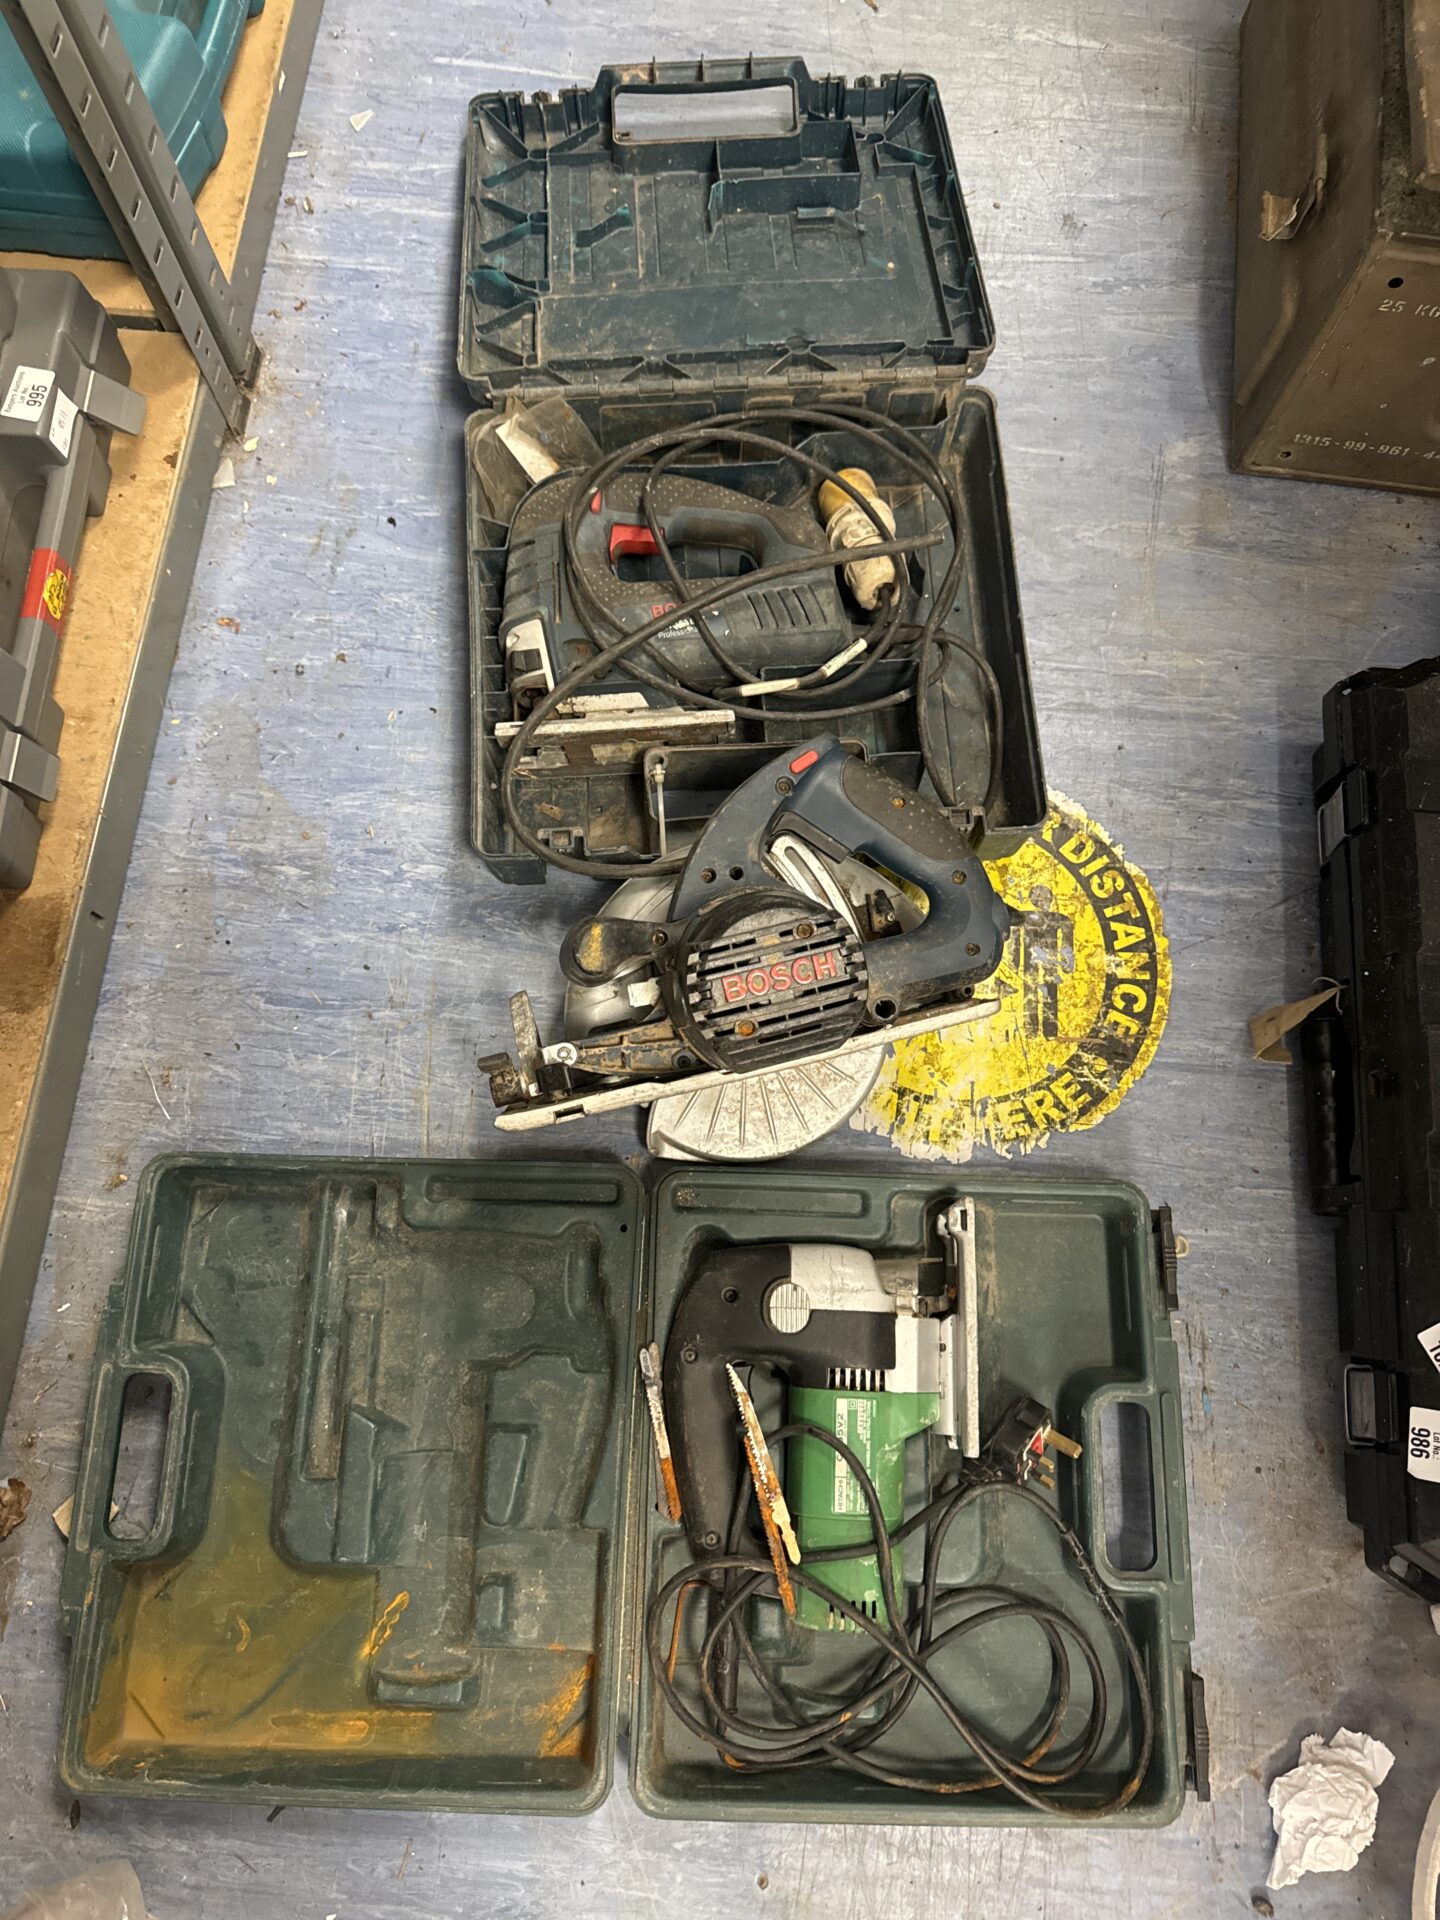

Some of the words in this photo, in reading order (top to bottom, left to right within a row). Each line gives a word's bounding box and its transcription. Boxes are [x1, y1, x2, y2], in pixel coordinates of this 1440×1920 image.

[1378, 299, 1407, 313] 25
[26, 384, 48, 407] 995
[1058, 830, 1153, 1043] DISTANCE
[721, 951, 838, 1004] BOSCH
[1411, 1427, 1431, 1459] 986
